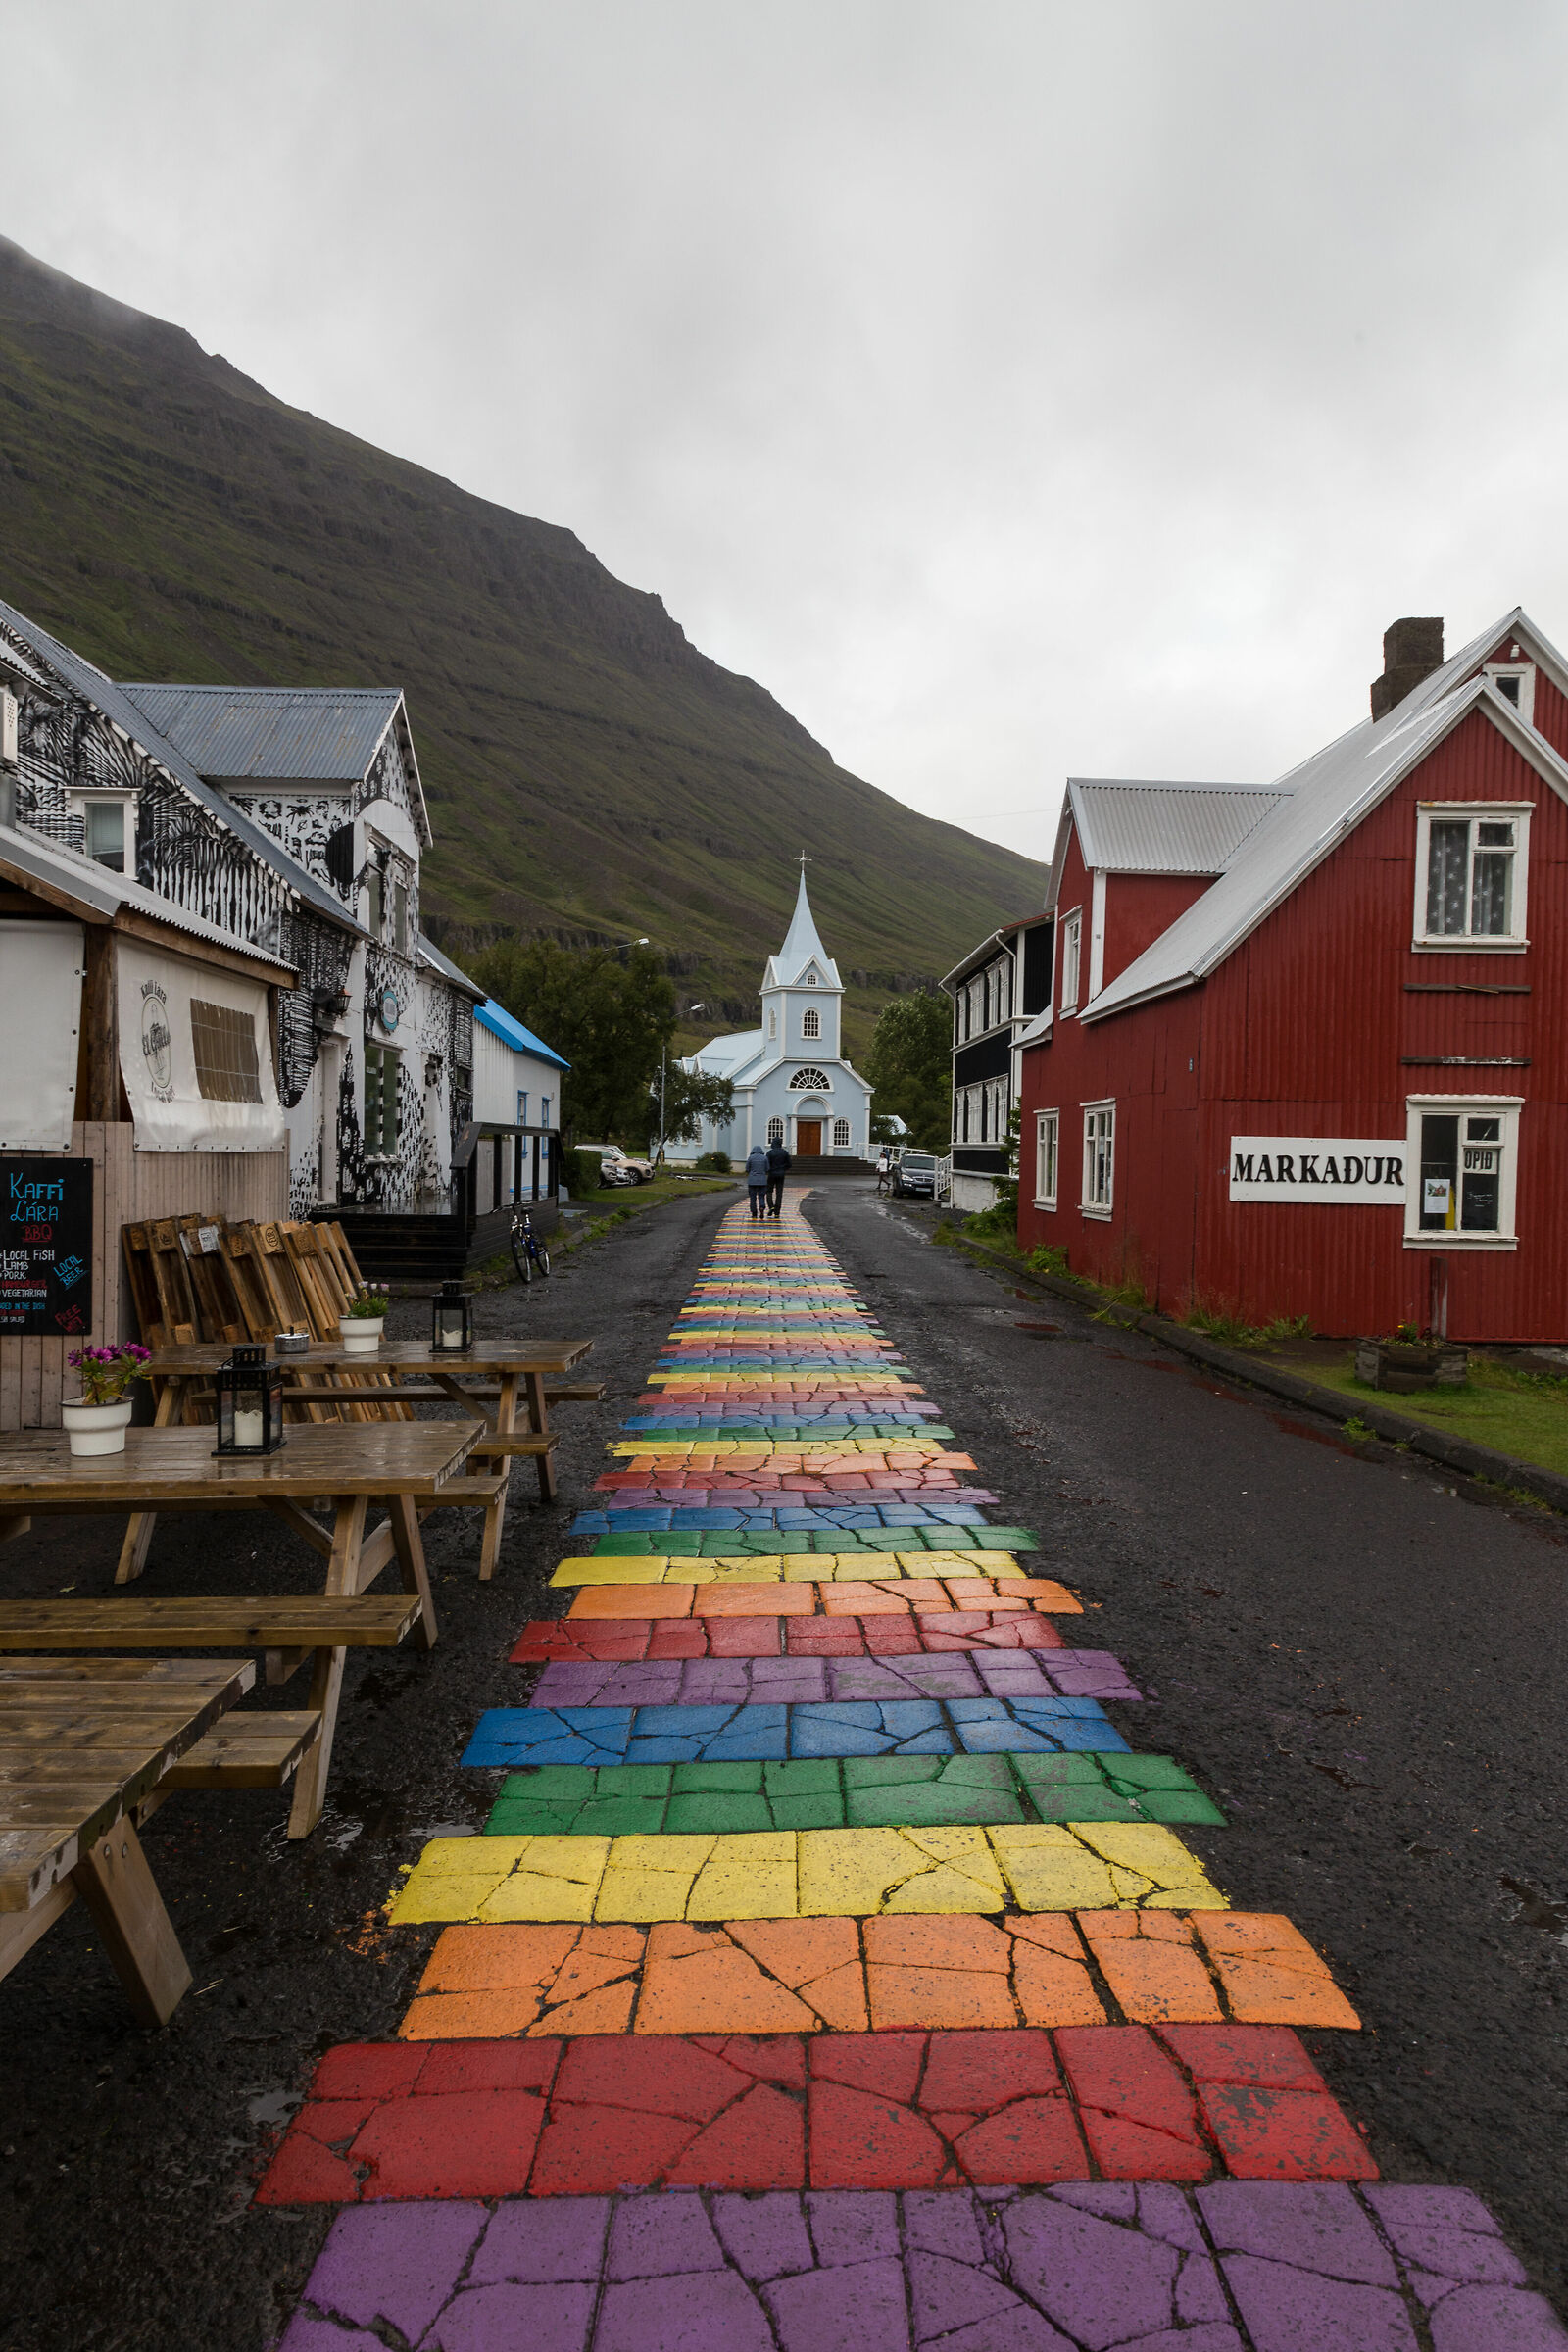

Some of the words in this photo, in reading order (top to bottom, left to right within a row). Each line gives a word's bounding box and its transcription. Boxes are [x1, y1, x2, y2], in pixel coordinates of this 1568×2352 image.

[1464, 1150, 1493, 1170] OPIÐ
[1232, 1153, 1404, 1186] MARKAÐUR
[22, 1224, 53, 1242] BBQ
[3, 1249, 30, 1261] LOCAL
[3, 1260, 29, 1271] LAMB
[53, 1254, 83, 1277] LOCAL
[2, 1270, 27, 1280] PORK
[60, 1266, 84, 1286] BEER
[2, 1288, 47, 1298] VEGETARIAN
